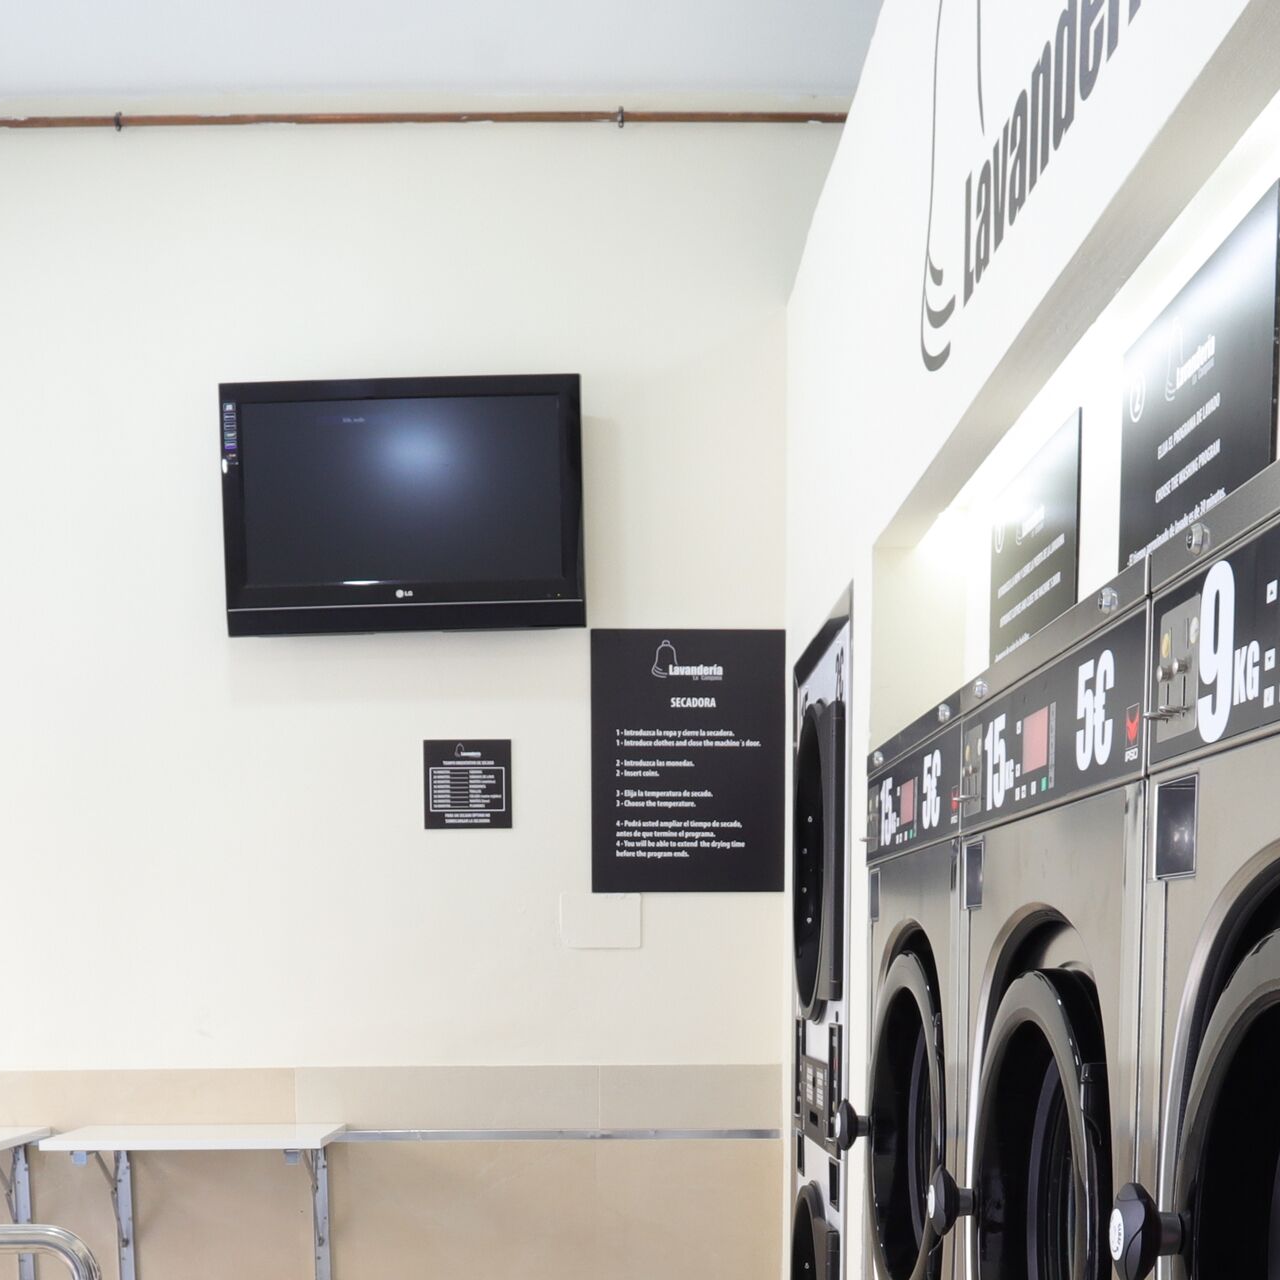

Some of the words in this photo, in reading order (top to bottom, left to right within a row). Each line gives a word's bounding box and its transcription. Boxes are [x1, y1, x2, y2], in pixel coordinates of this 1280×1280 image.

[669, 664, 723, 676] Lavandería
[670, 697, 717, 708] SECADORA
[1076, 649, 1115, 771] 5€
[624, 790, 637, 798] Elija
[922, 749, 941, 829] 5€
[660, 820, 682, 828] ampliar
[690, 820, 711, 828] tiempo
[711, 840, 730, 849] drying
